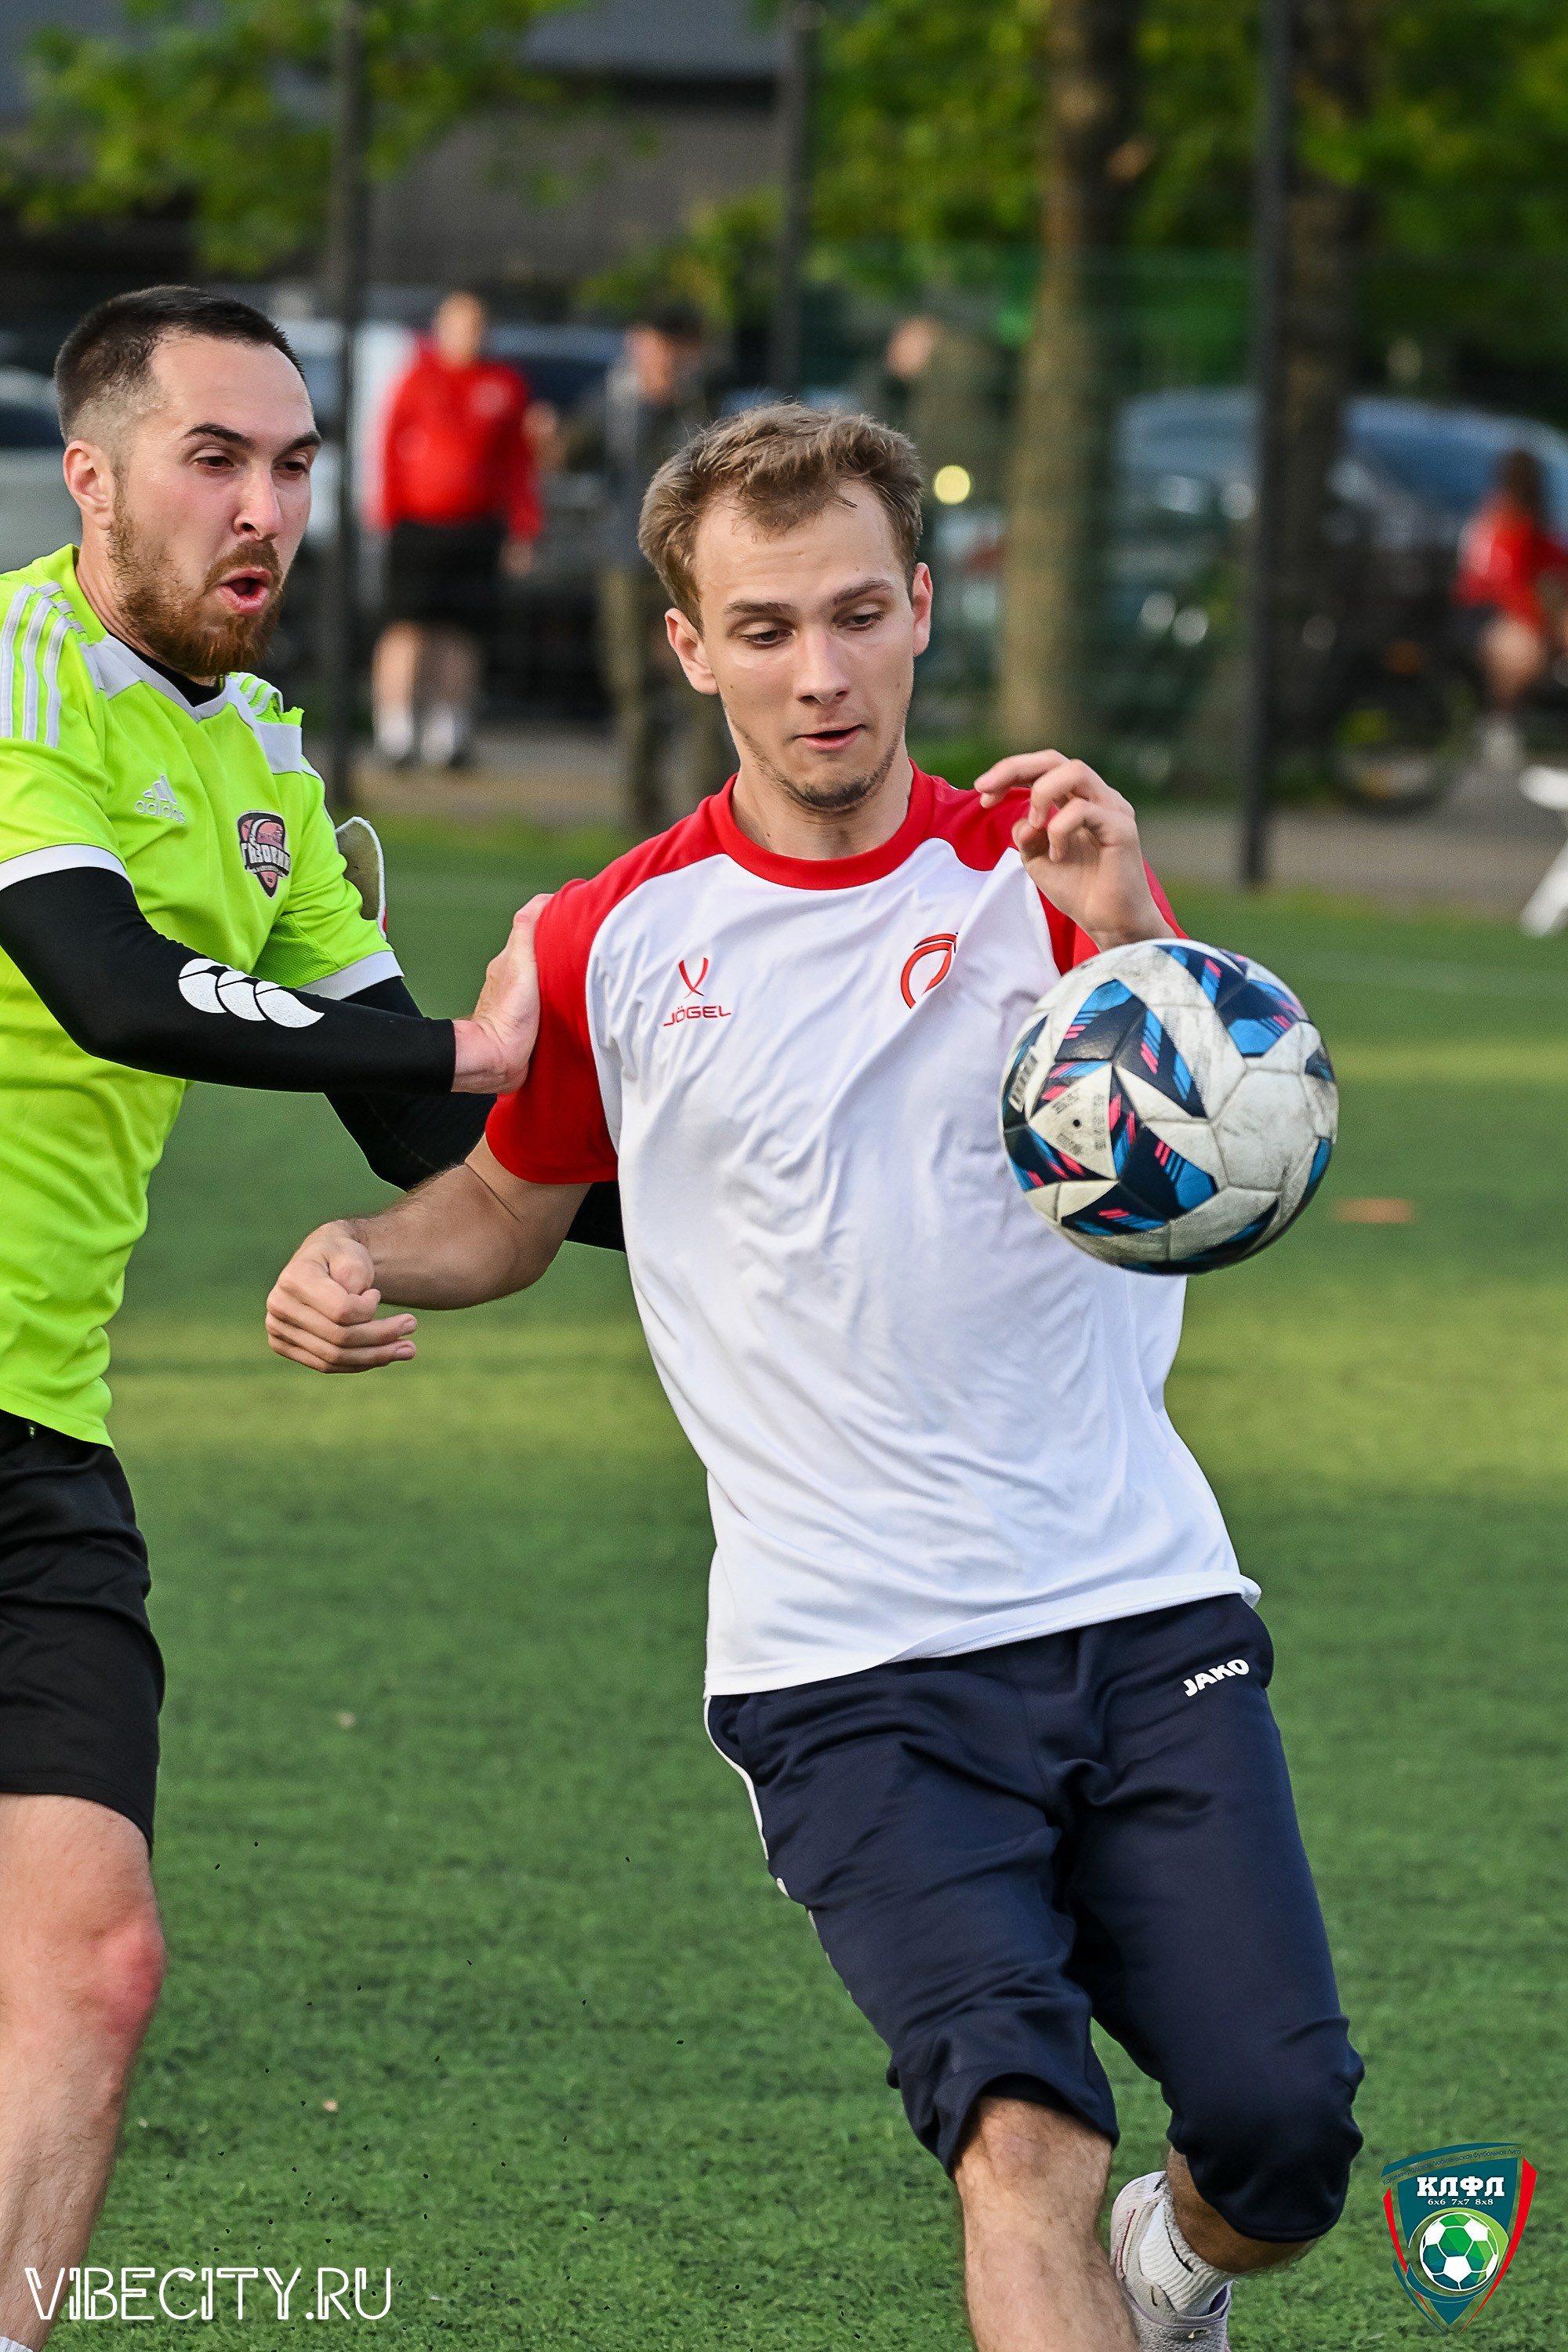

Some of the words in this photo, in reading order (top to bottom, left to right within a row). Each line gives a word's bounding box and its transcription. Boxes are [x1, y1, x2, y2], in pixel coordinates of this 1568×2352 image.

[135, 800, 186, 824] adidas
[662, 1005, 732, 1027] JÖGEL
[1182, 1659, 1250, 1697] JAKO
